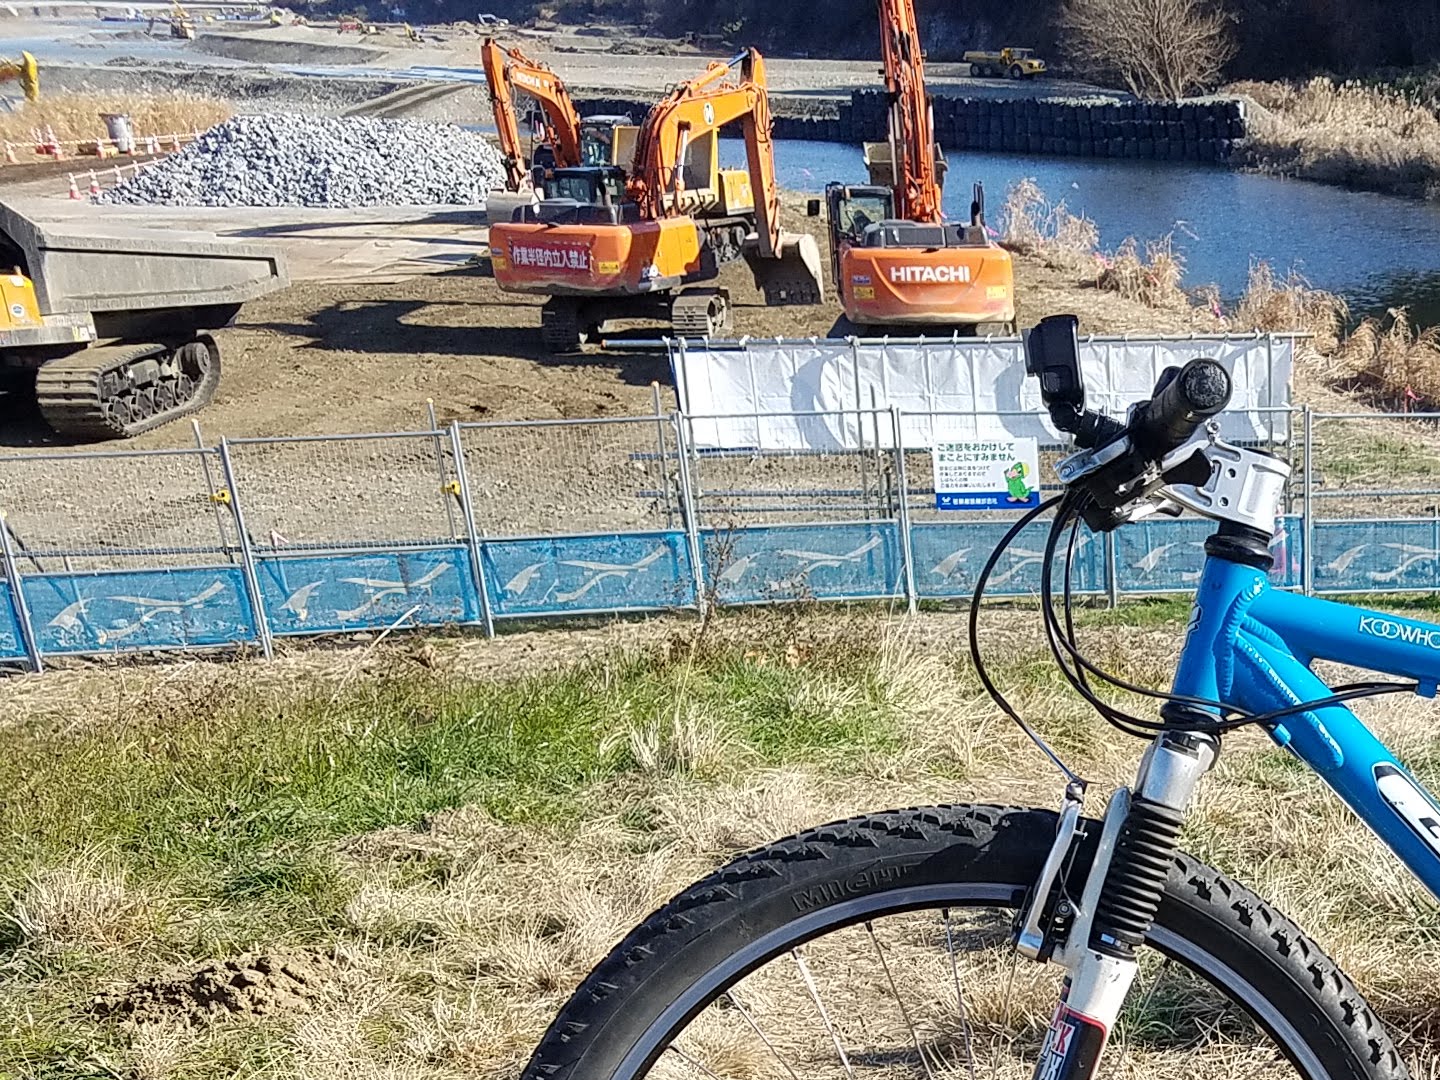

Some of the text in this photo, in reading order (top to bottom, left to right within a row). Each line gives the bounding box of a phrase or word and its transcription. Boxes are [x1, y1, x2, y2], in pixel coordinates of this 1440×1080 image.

[513, 246, 588, 269] 作業半径内立入禁止
[891, 266, 970, 282] HITACHI
[938, 453, 1016, 462] まことにすみません
